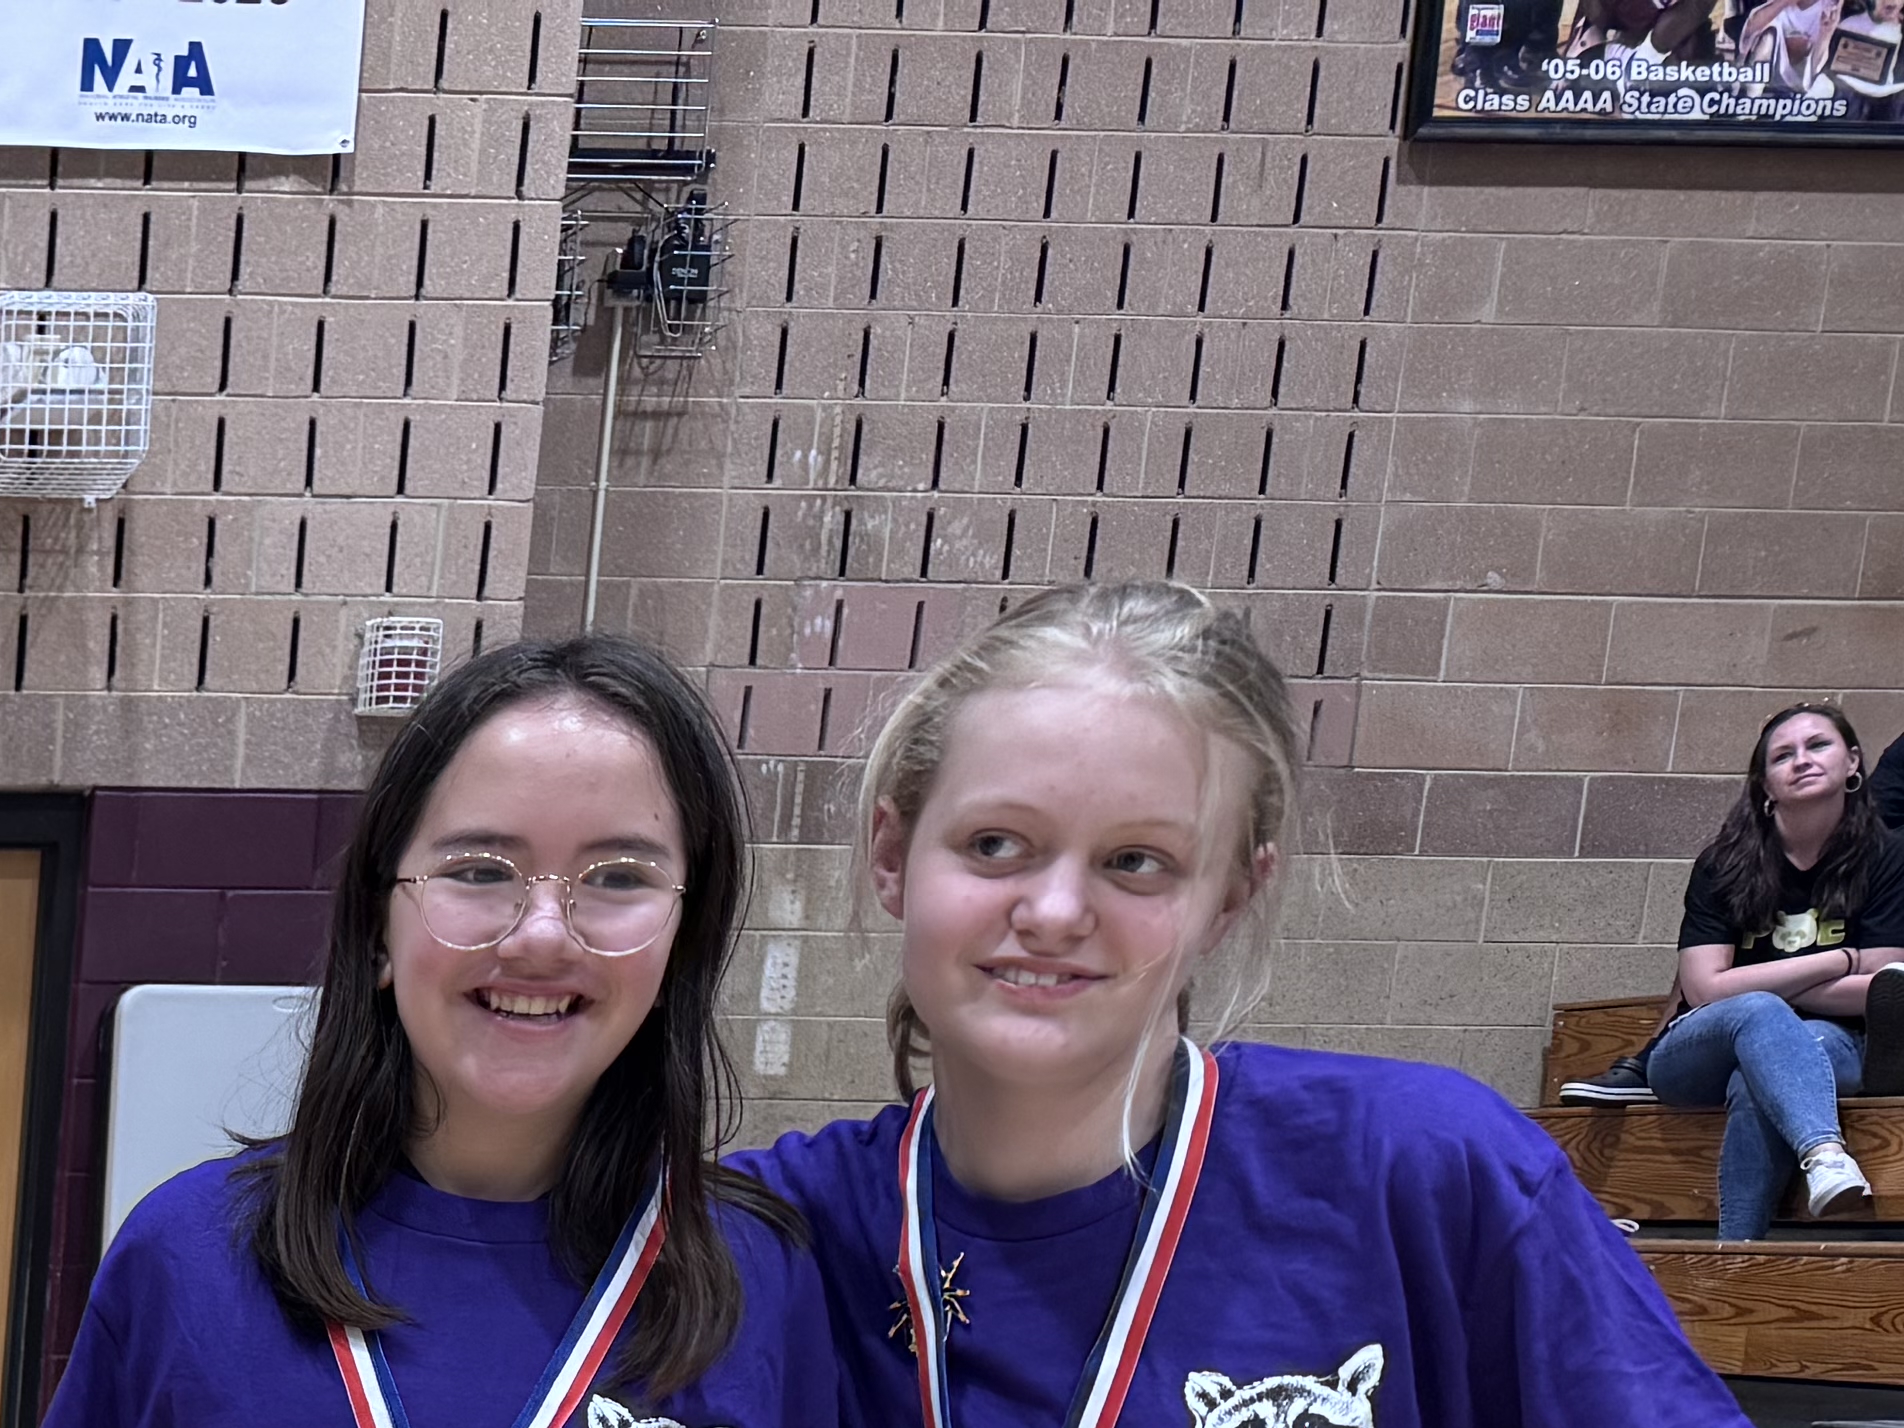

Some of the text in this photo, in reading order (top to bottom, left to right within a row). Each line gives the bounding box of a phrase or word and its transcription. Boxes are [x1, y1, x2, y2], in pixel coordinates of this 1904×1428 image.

[80, 37, 216, 97] NATA
[1630, 59, 1771, 83] Basketball
[1458, 89, 1848, 118] Class AAAA State Champions
[94, 111, 198, 129] www.nata.org
